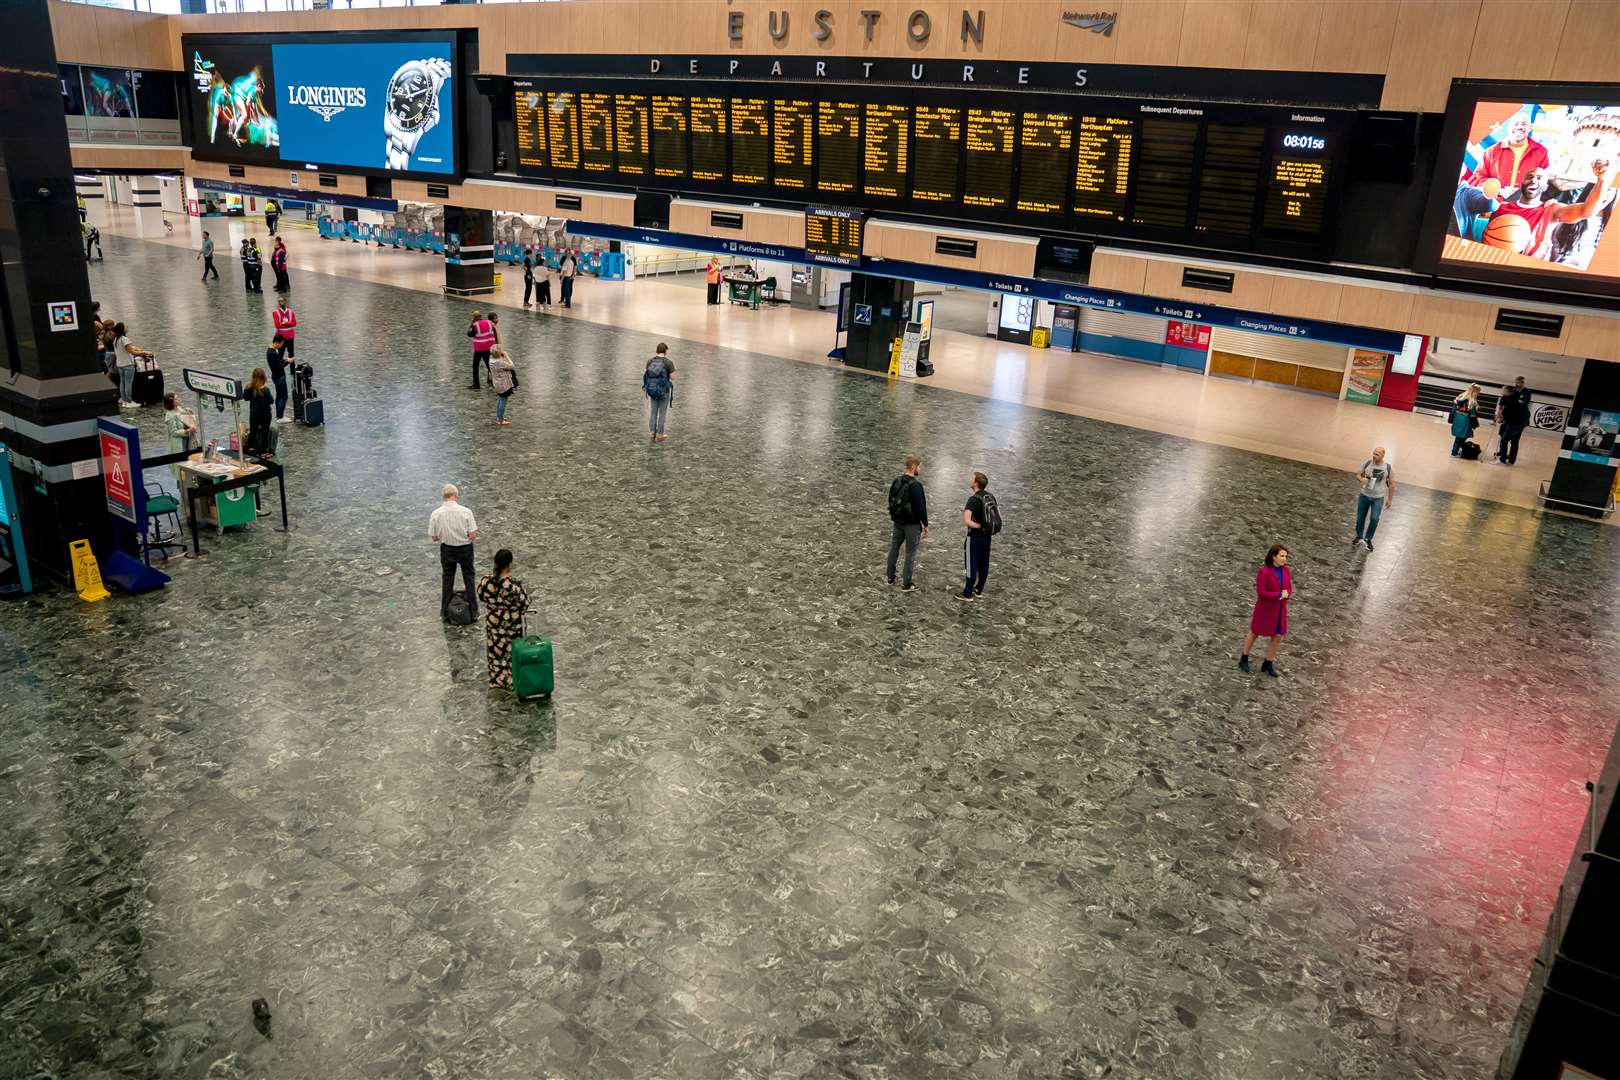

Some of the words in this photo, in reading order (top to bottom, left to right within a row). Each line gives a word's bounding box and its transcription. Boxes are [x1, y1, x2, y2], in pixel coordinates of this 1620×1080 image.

[728, 10, 985, 43] EUSTON
[650, 59, 1088, 86] DEPARTURES
[288, 85, 367, 107] LONGINES
[1140, 105, 1172, 114] Subsequent
[1172, 106, 1203, 116] Departures
[1023, 119, 1045, 127] Liverpool
[1291, 114, 1325, 123] Information
[814, 209, 837, 217] ARRIVALS
[738, 244, 765, 254] Platforms
[814, 255, 837, 263] ARRIVALS
[994, 282, 1013, 291] Toilets
[1064, 293, 1089, 304] Changing
[1089, 296, 1105, 305] Places
[1162, 307, 1183, 317] Toilets
[1240, 319, 1268, 330] Changing
[1268, 323, 1287, 333] Places
[1536, 415, 1563, 424] KING
